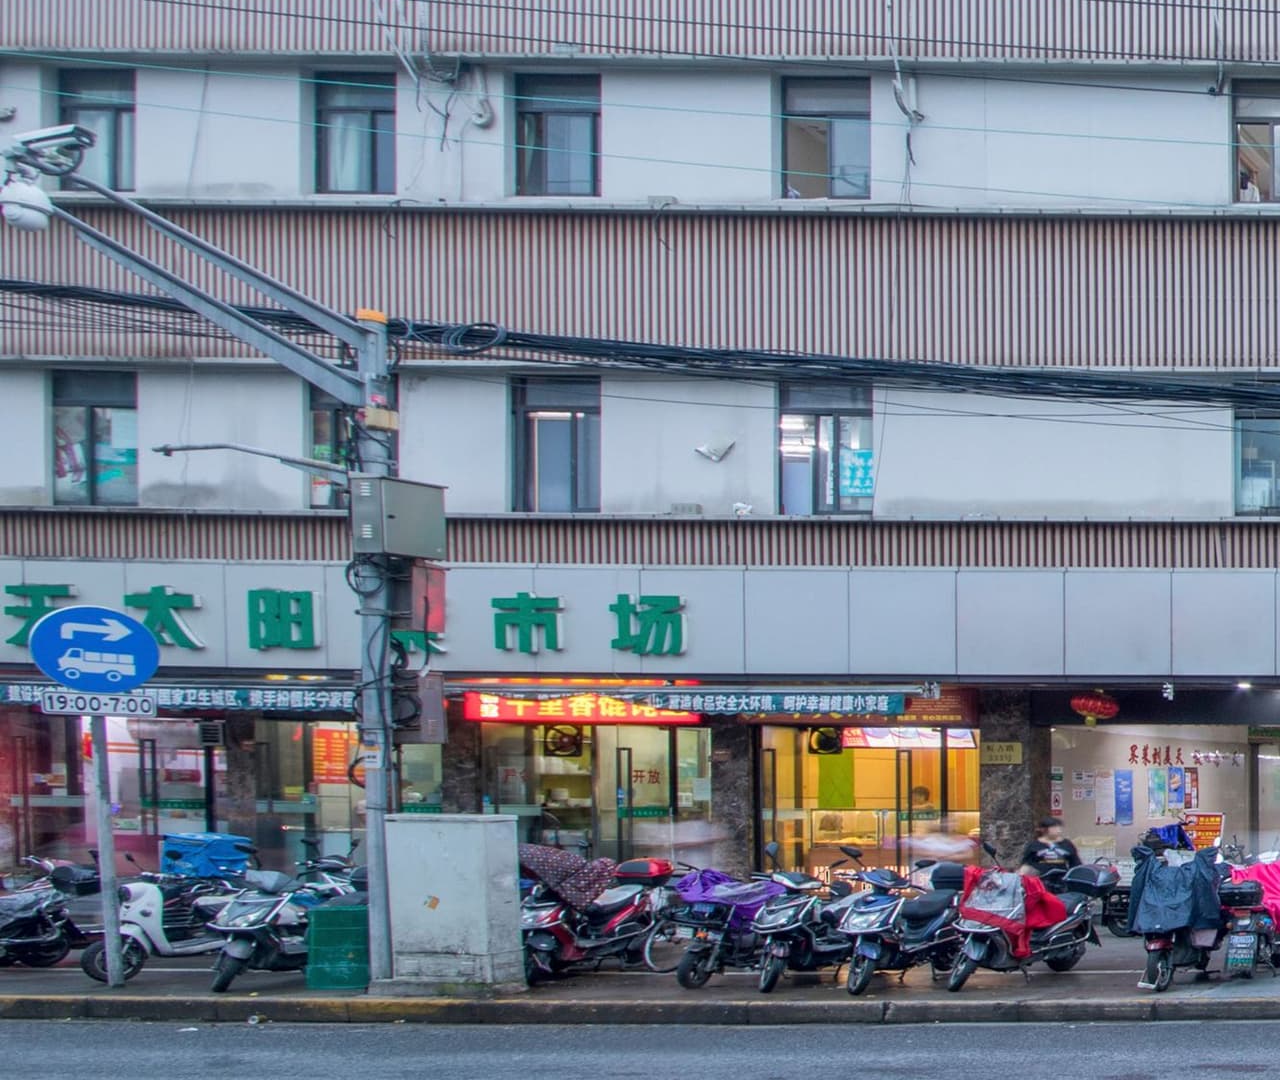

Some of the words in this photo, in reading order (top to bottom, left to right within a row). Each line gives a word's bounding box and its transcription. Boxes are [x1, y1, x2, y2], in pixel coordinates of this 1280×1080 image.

[4, 584, 687, 656] 天太阳市场
[46, 694, 152, 714] 19:00-7:00
